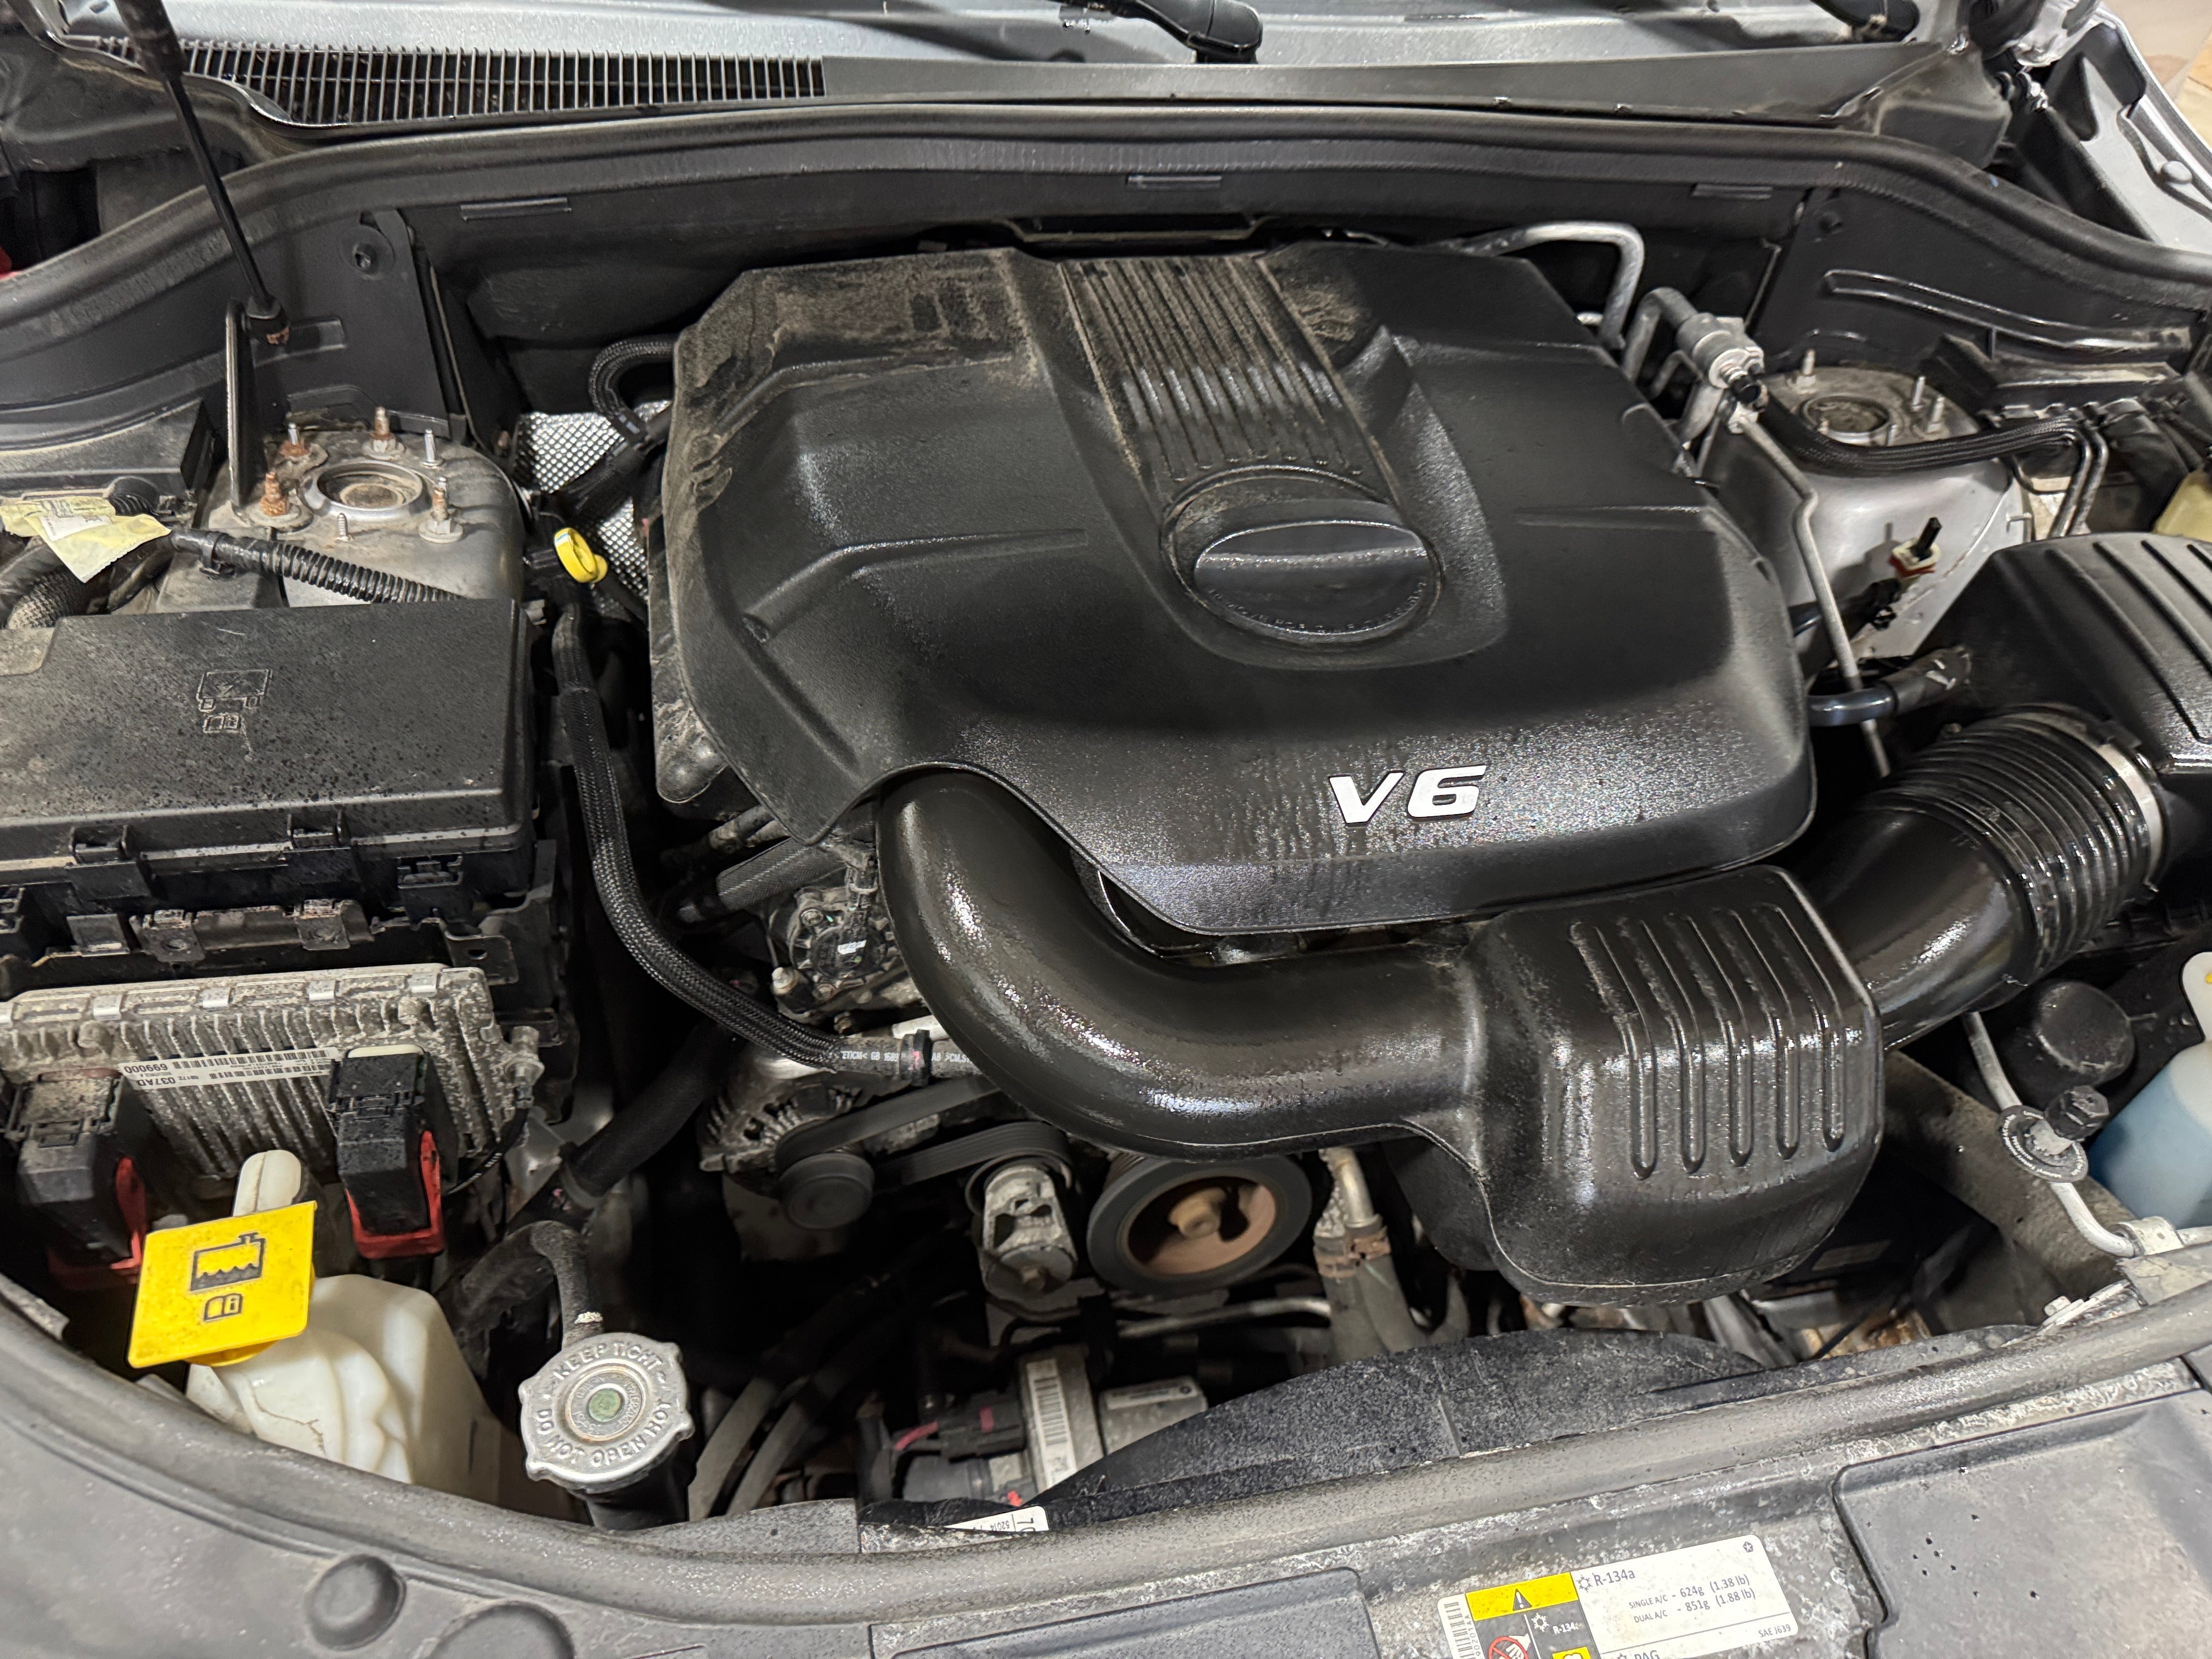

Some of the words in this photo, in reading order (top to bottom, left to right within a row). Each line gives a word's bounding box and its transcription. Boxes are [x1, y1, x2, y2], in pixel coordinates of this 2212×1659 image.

[1329, 765, 1487, 824] V6
[123, 1063, 168, 1074] 699000
[137, 1077, 176, 1086] 037AD
[552, 1343, 607, 1380] KEEP
[613, 1340, 662, 1370] TIGHT
[536, 1408, 554, 1435] DO
[644, 1399, 671, 1437] HOT
[544, 1435, 585, 1464] NOT
[591, 1435, 646, 1467] OPEN
[1593, 1568, 1636, 1587] R-134a
[1628, 1598, 1654, 1609] SINGLE
[1655, 1594, 1668, 1604] A/C
[1680, 1585, 1705, 1598] 624g
[1709, 1577, 1735, 1593] (1.38
[1735, 1573, 1750, 1586] lb)
[1633, 1613, 1654, 1623] DUAL
[1655, 1610, 1668, 1619] A/C
[1685, 1600, 1711, 1612] 851g
[1715, 1591, 1741, 1607] (1.88
[1741, 1587, 1756, 1600] lb)
[1758, 1629, 1774, 1638] SAE
[1775, 1623, 1792, 1635] J639
